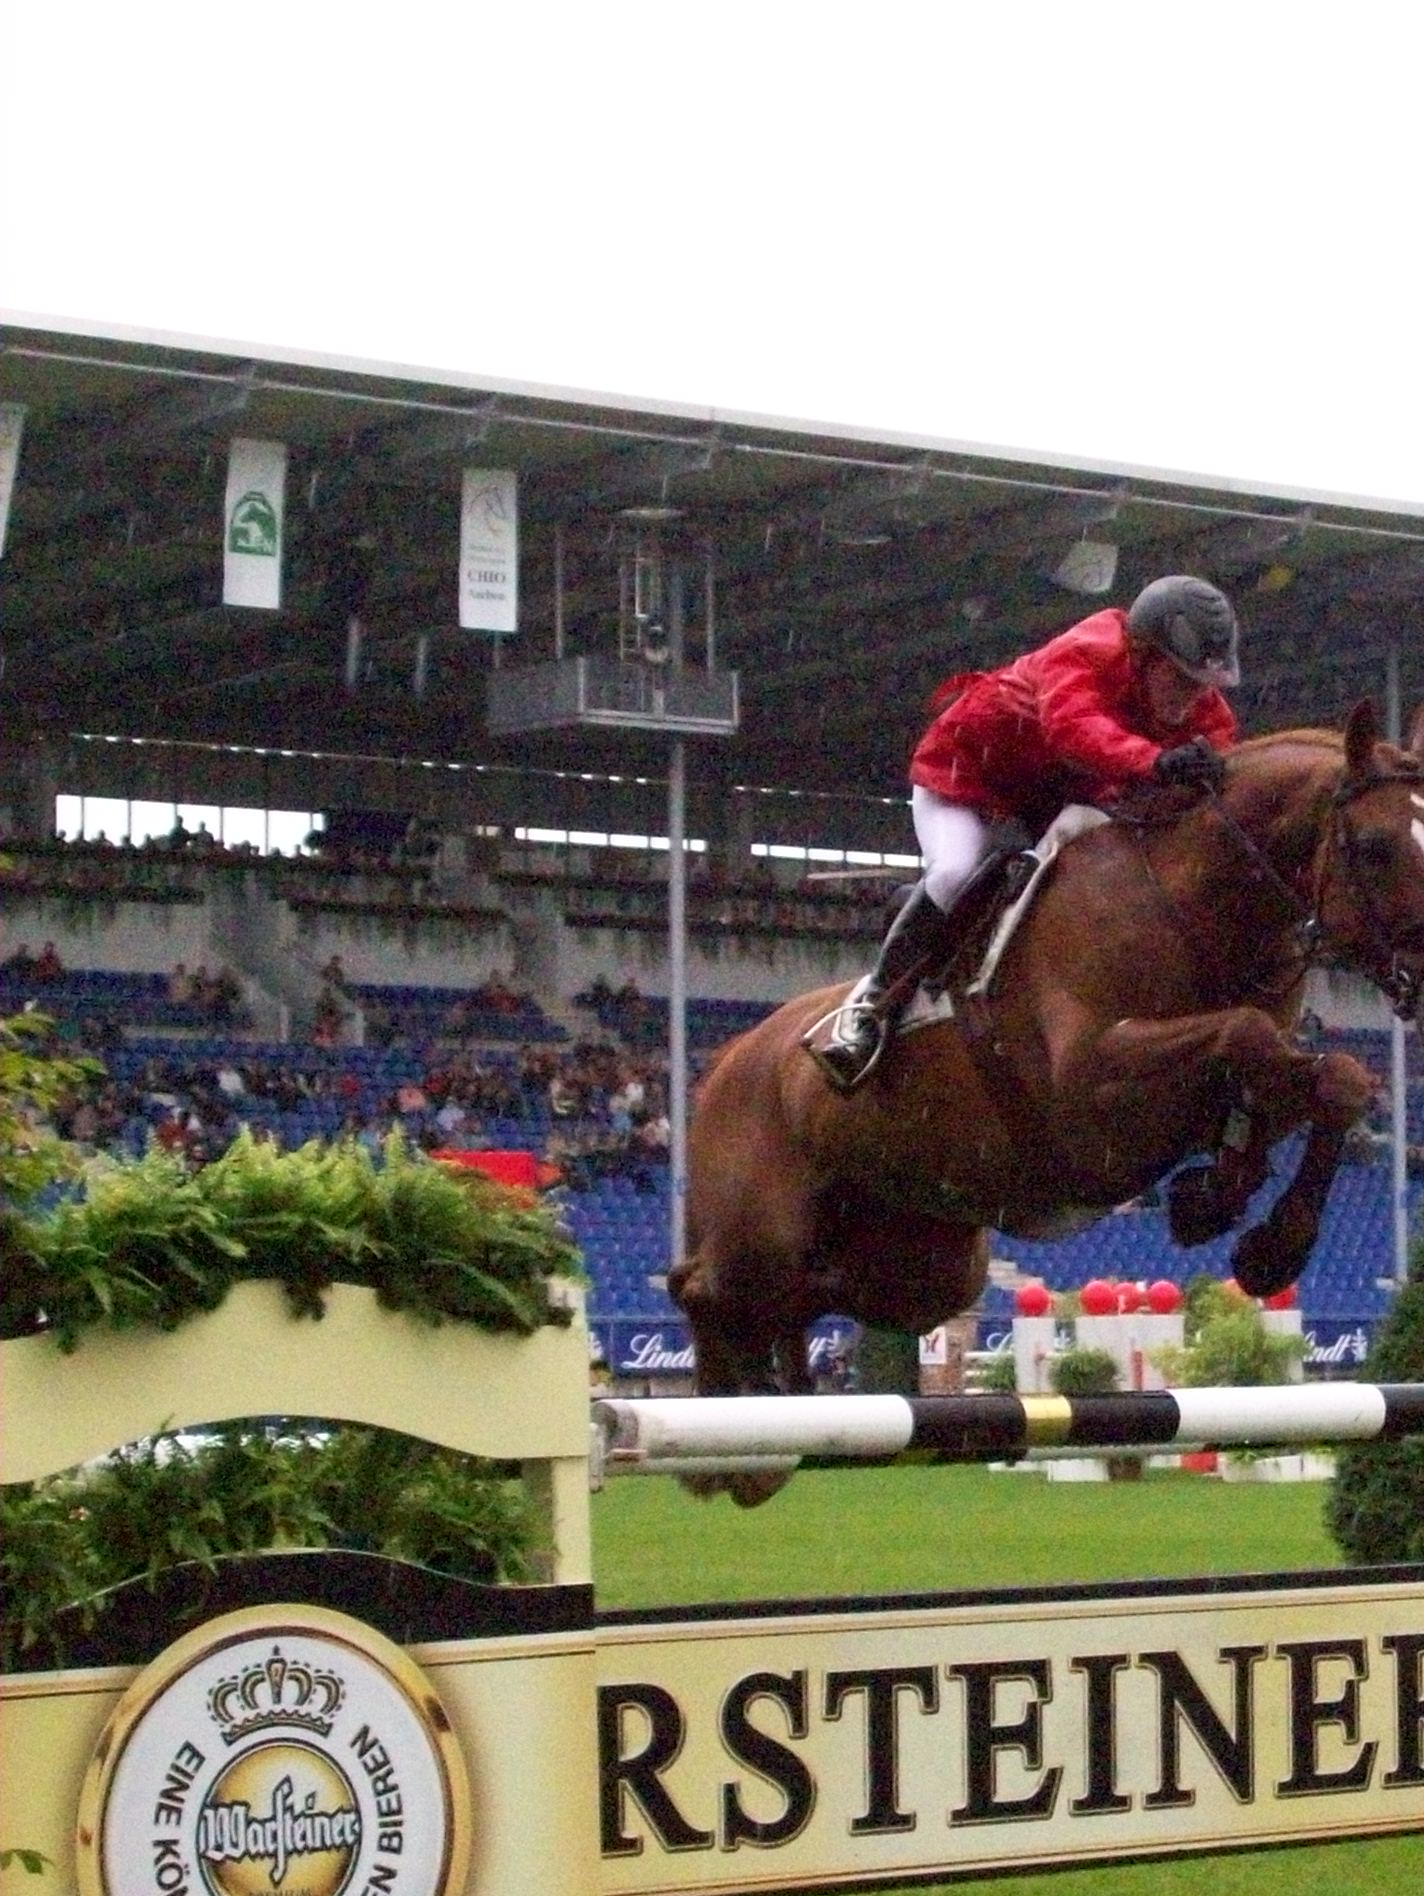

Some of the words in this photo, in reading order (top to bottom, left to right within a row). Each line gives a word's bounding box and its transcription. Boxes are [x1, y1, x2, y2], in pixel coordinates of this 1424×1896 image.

[467, 568, 506, 584] CHIO
[621, 1334, 696, 1369] Lind
[154, 1740, 206, 1827] EINE
[350, 1723, 403, 1854] BIEREN
[199, 1774, 361, 1888] Warsteiner
